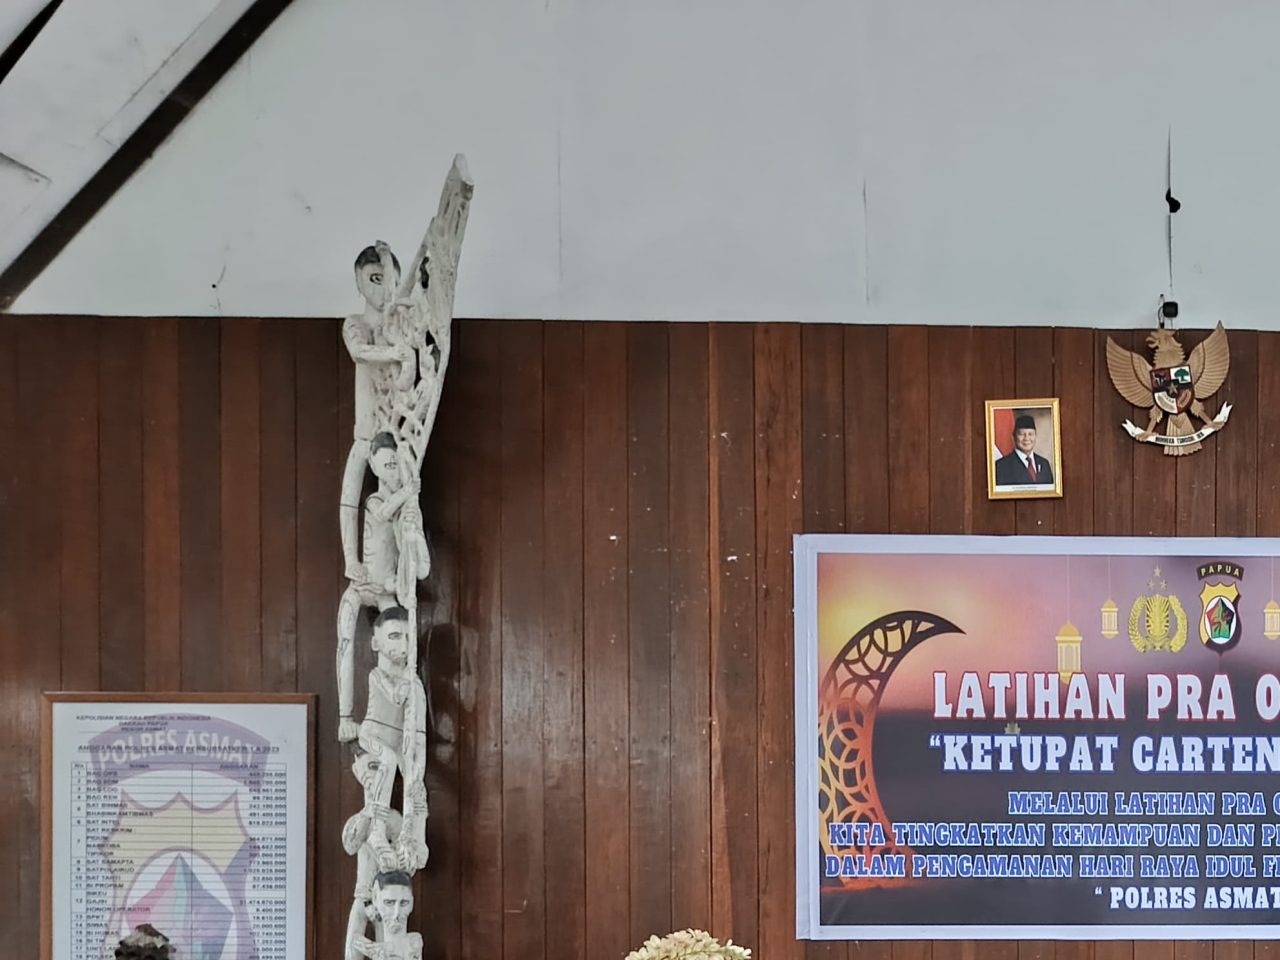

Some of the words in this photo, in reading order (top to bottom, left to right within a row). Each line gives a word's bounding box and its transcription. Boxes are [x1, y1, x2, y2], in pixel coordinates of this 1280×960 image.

[1200, 564, 1240, 577] PAPUA
[932, 671, 1127, 720] LATIHAN
[1146, 672, 1237, 721] PRA
[97, 729, 178, 771] POLRES
[183, 729, 255, 769] ASMAT
[1007, 791, 1109, 815] MELALUI
[1114, 791, 1216, 816] LATIHAN
[1221, 791, 1267, 816] PRA
[828, 822, 885, 847] KITA
[891, 822, 1046, 847] TINGKATKAN
[1052, 823, 1201, 847] KEMAMPUAN
[1206, 823, 1256, 847] DAN
[824, 854, 906, 878] DALAM
[911, 854, 1074, 878] PENGAMANAN
[1078, 854, 1135, 878] HARI
[1140, 854, 1200, 878] RAYA
[1205, 854, 1257, 878] IDUL
[1109, 886, 1197, 910] POLRES
